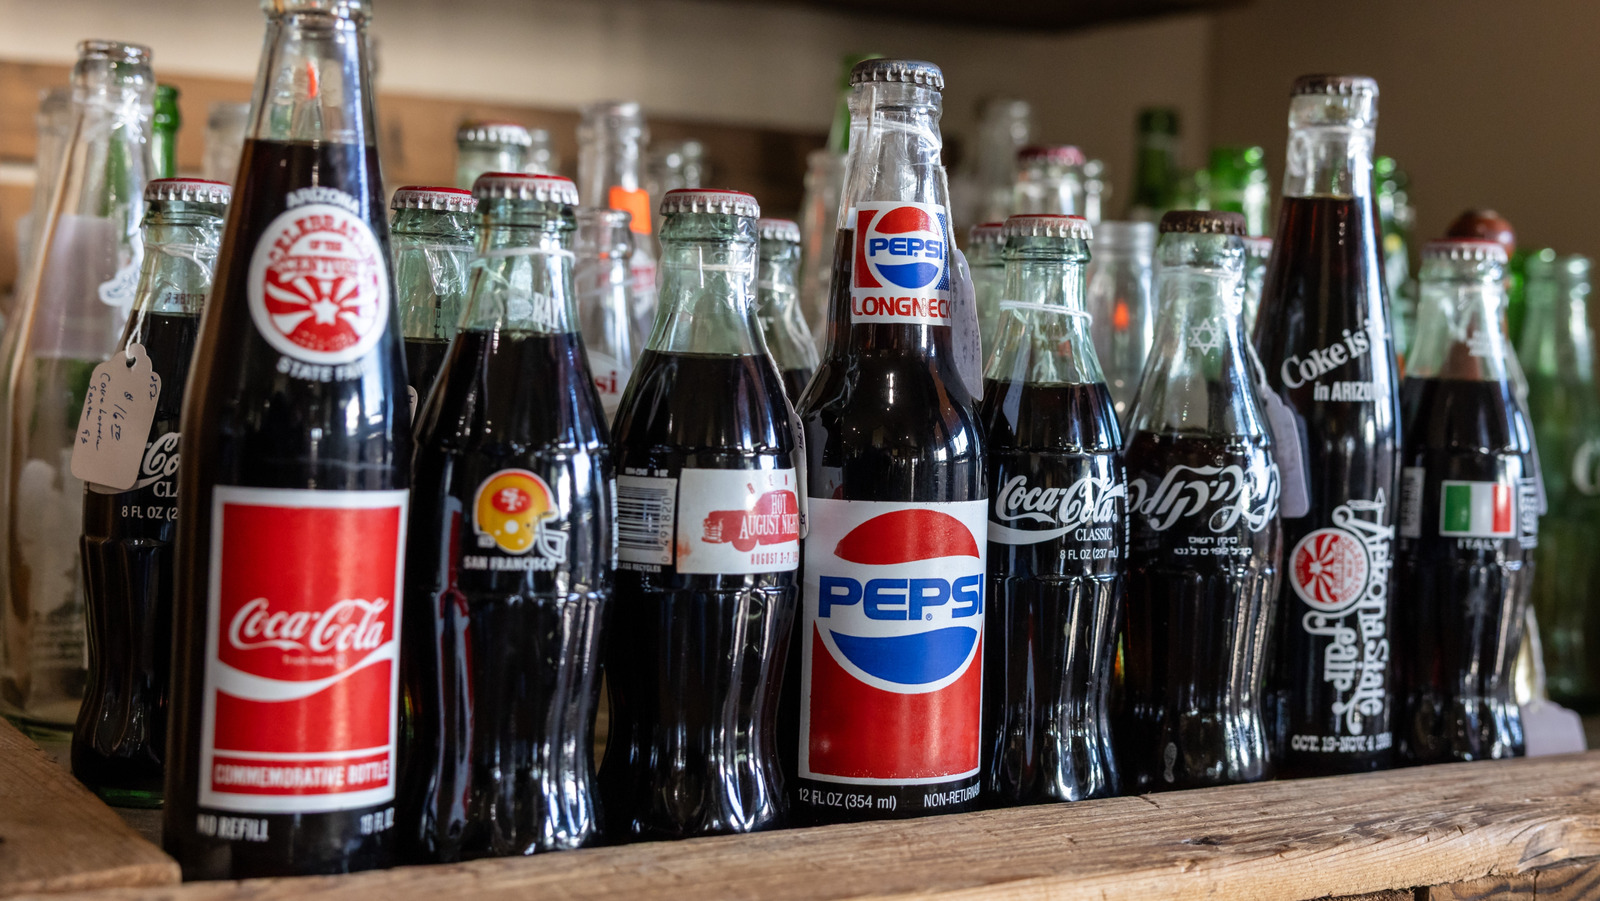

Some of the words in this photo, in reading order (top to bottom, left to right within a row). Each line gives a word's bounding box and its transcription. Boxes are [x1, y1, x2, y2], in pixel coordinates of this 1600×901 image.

[286, 186, 360, 213] ARIZONA
[869, 237, 943, 260] PEPSI
[276, 355, 333, 382] STATE
[335, 361, 368, 382] FAI
[1280, 342, 1349, 389] Coke
[1342, 328, 1370, 359] is
[1313, 381, 1330, 401] in
[771, 494, 787, 515] HOT
[995, 475, 1119, 524] Coca-Cola
[121, 505, 128, 518] 8
[131, 505, 144, 519] FL
[147, 506, 163, 519] OZ
[166, 506, 178, 522] (2
[739, 514, 780, 540] AUGUST
[1075, 528, 1112, 541] CLASSIC
[1060, 550, 1066, 560] 8
[1068, 550, 1078, 560] FL
[1080, 549, 1091, 559] OZ
[1093, 547, 1107, 560] (237
[1457, 538, 1503, 551] ITALY
[463, 555, 488, 570] SAN
[489, 556, 556, 571] FRANCISCO
[751, 552, 778, 565] AUGUST
[818, 573, 984, 621] PEPSI
[229, 598, 389, 652] Coca-Cola
[214, 763, 345, 787] COMMEMORATIVE
[347, 759, 389, 785] BOTTLE
[799, 787, 809, 802] 12
[812, 790, 825, 804] FL
[827, 792, 843, 807] OZ
[845, 794, 873, 810] (354
[877, 795, 897, 811] ml)
[924, 780, 980, 808] NON-RETURNA
[197, 813, 217, 836] NO
[217, 816, 269, 842] REFILL
